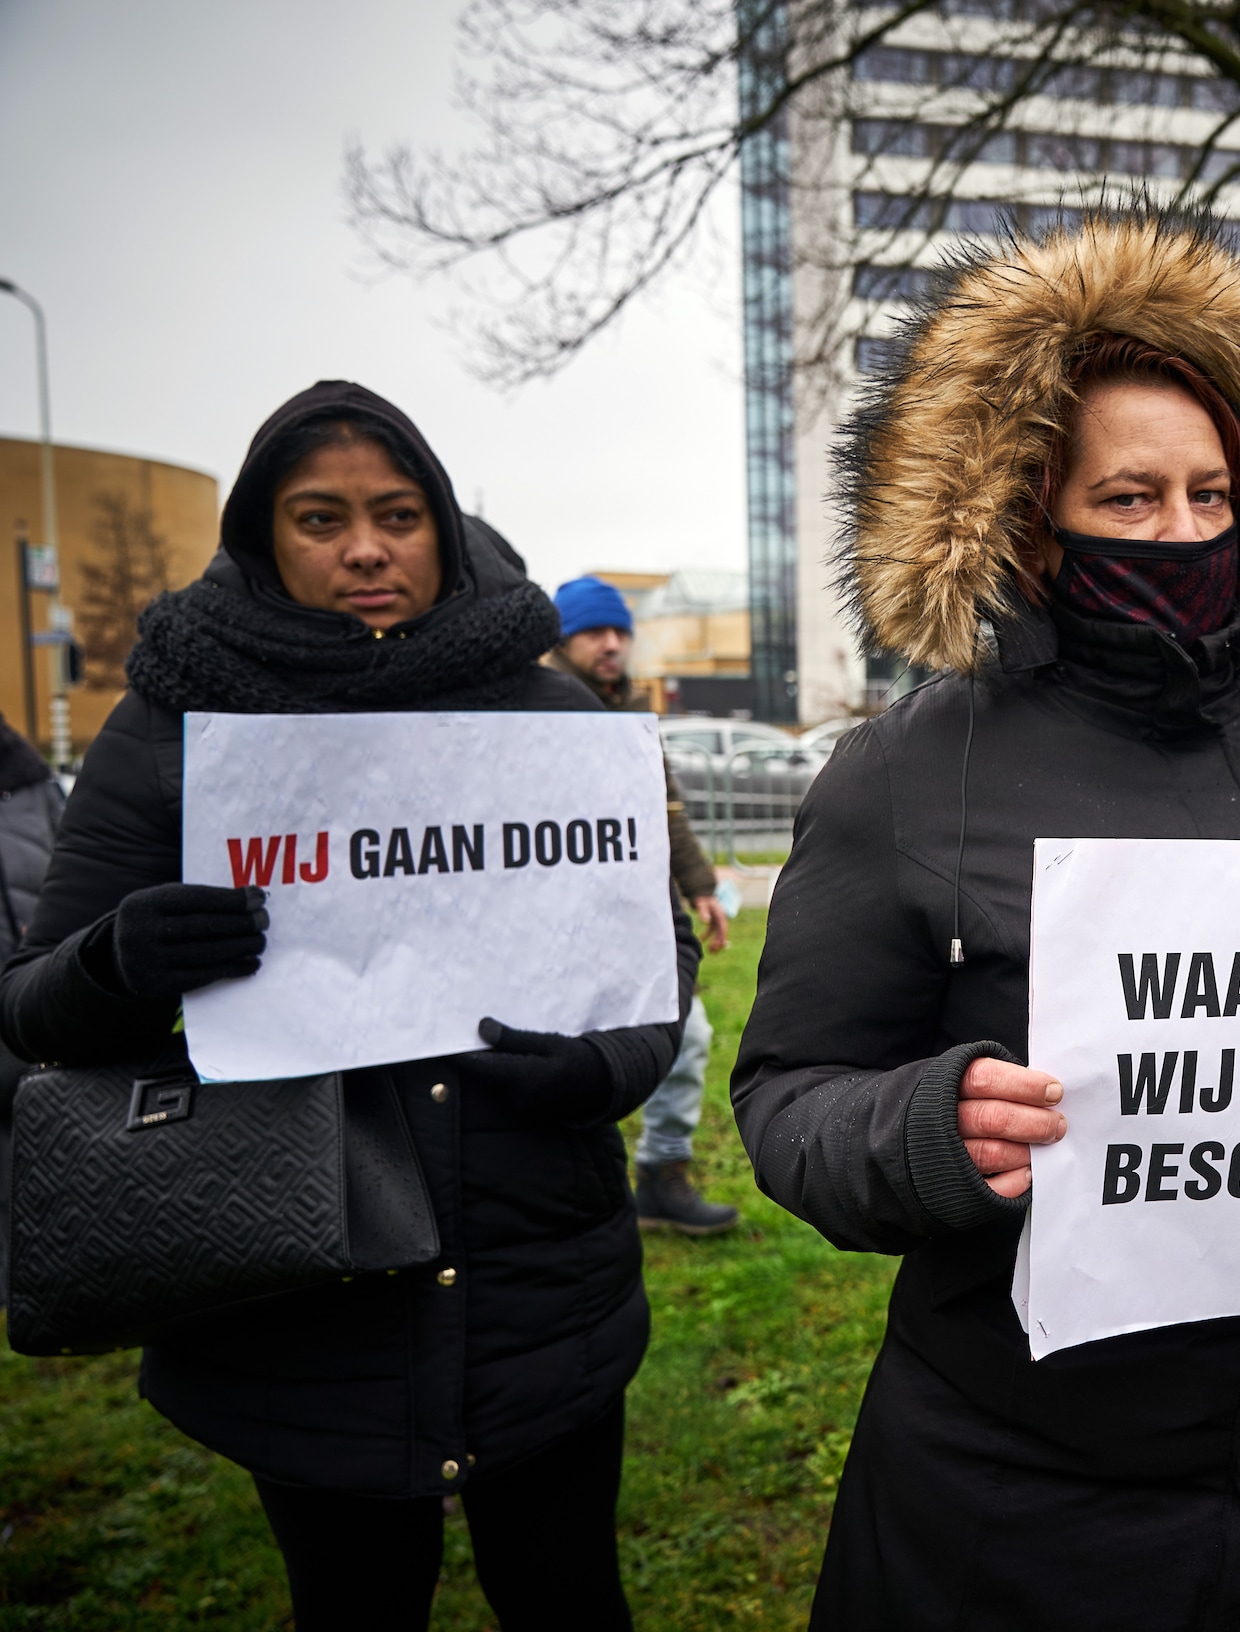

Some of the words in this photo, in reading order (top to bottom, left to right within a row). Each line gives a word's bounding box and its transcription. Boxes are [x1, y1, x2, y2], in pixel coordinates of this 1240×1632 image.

[227, 831, 329, 888] WIJ
[349, 823, 485, 880] GAAN
[502, 817, 638, 869] DOOR!
[1116, 1048, 1236, 1116] WIJ
